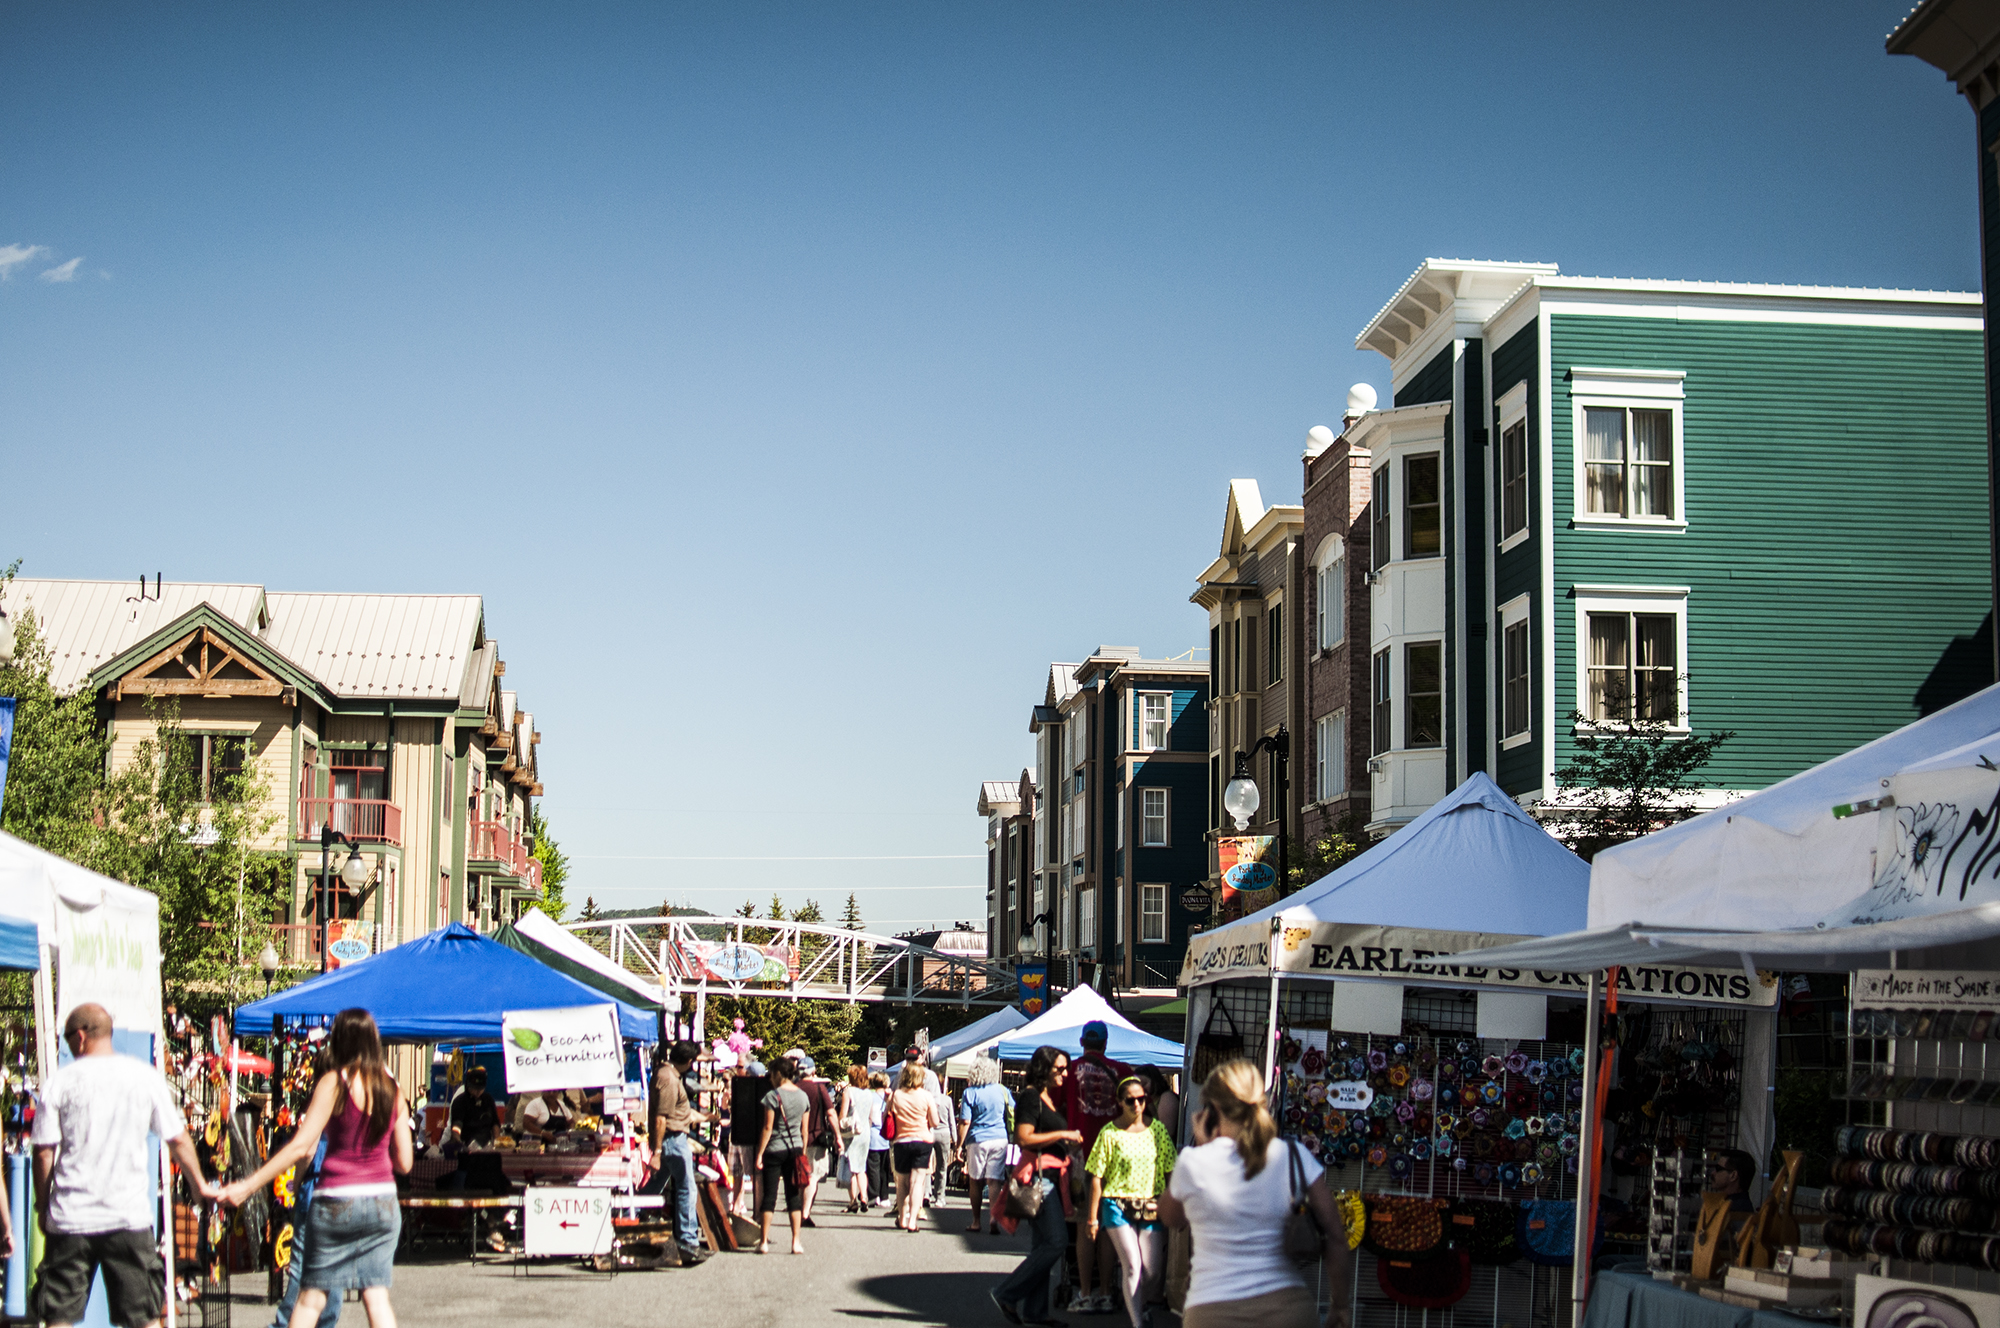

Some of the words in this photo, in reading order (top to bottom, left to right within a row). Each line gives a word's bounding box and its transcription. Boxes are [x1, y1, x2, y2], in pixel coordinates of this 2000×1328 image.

[550, 1033, 604, 1046] Eco-Art
[515, 1049, 615, 1066] Eco-Furniture
[549, 1199, 589, 1214] ATM
